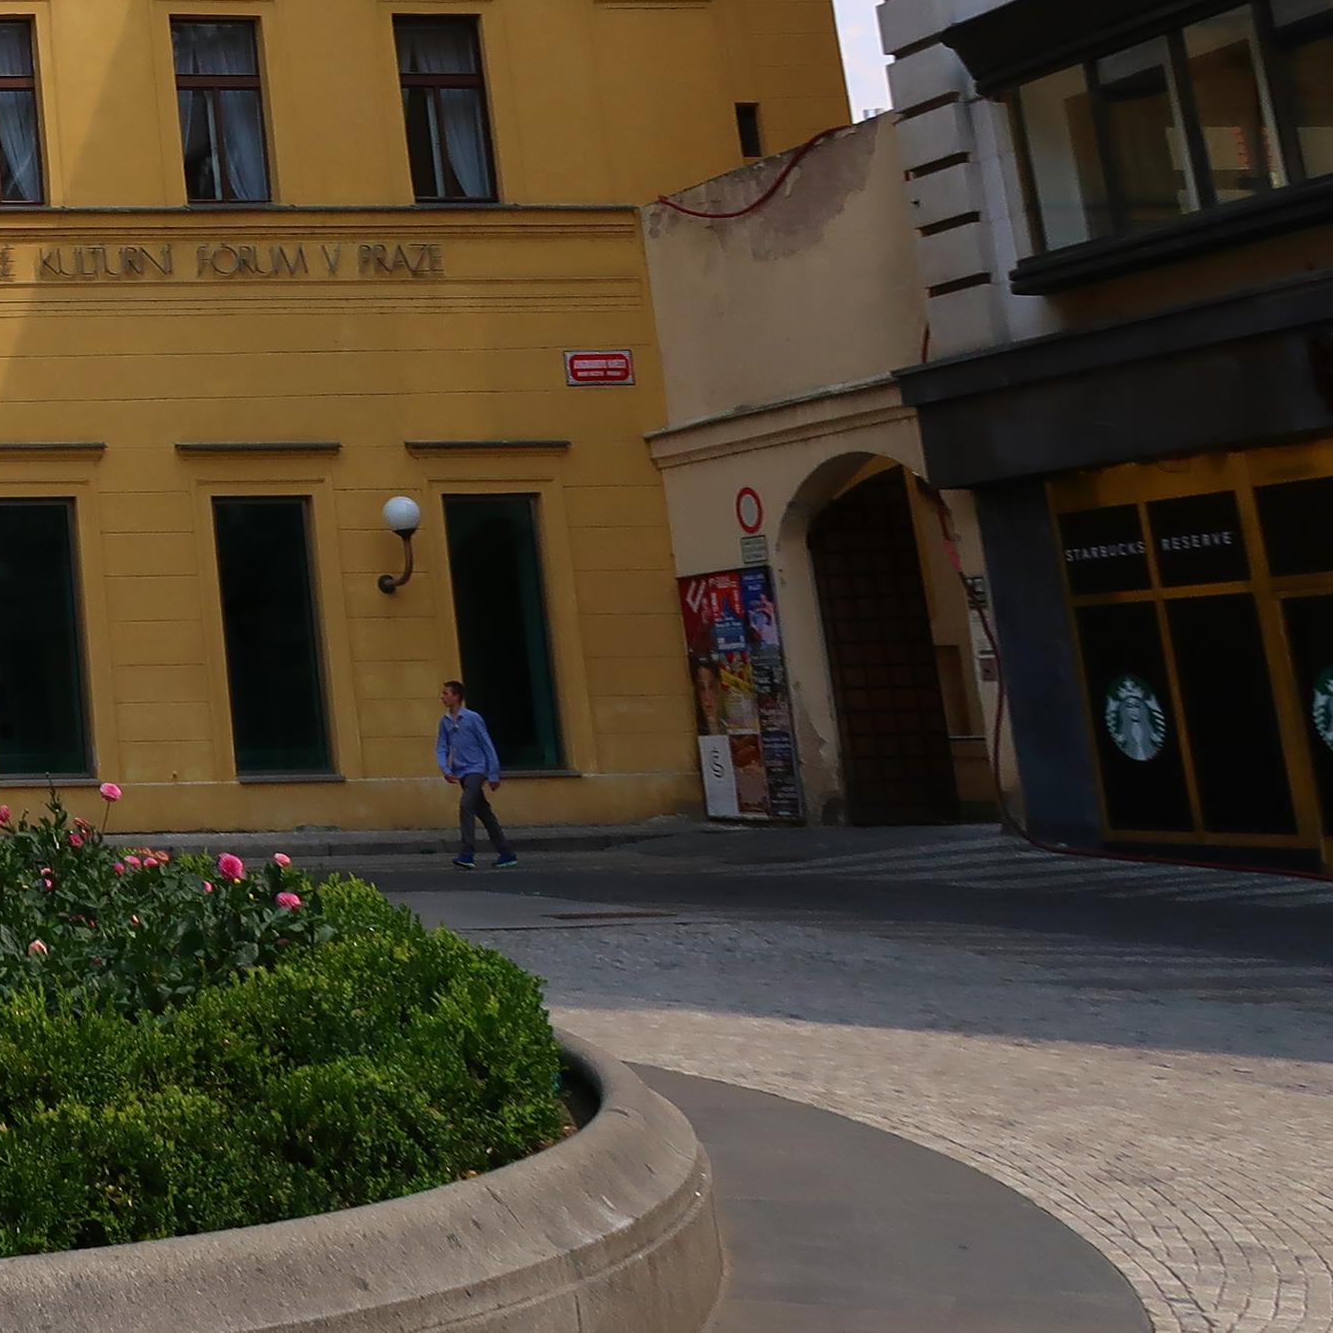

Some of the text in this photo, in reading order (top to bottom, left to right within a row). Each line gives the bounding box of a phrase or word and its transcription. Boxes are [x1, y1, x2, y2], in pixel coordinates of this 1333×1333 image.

[321, 243, 342, 276] V
[357, 243, 445, 276] PRAZE
[1064, 531, 1233, 562] STARBUCKS RESERVE
